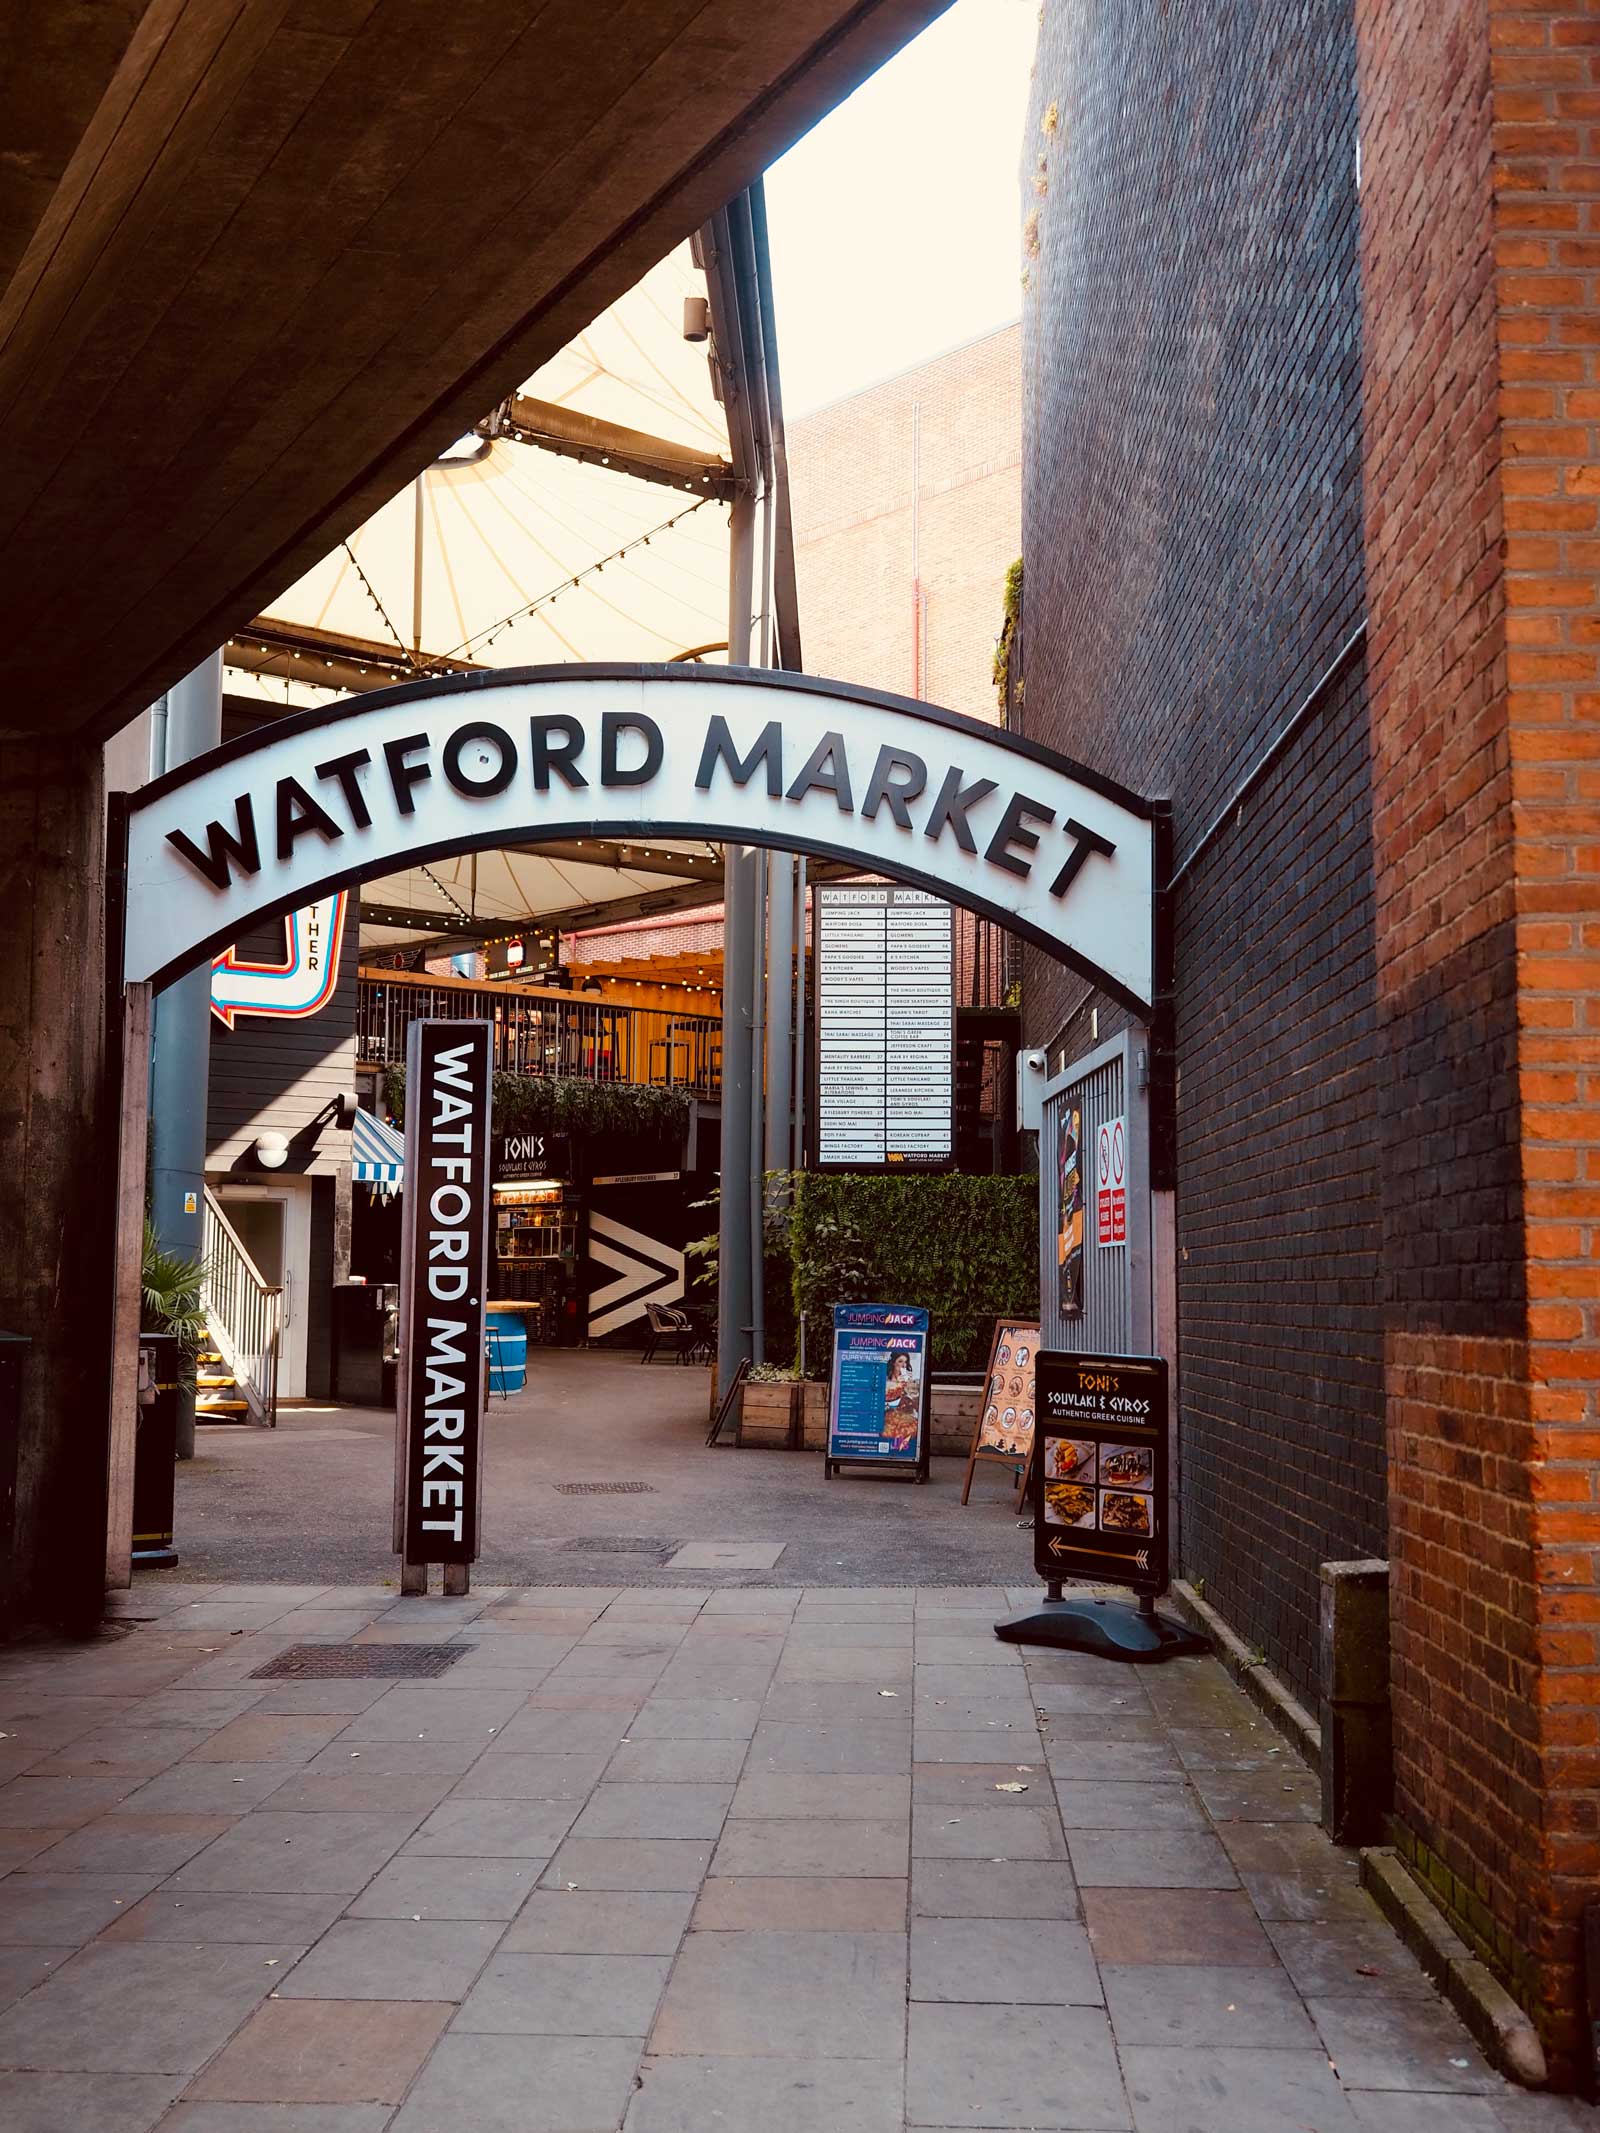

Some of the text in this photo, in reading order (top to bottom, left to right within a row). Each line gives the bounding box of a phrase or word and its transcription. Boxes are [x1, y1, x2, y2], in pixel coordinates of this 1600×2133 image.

[165, 712, 1117, 898] WATFORD MARKET
[504, 1135, 544, 1160] TONI'S
[422, 1042, 474, 1542] WATFORD MARKET
[848, 1313, 914, 1325] JUMPING JACK
[850, 1337, 888, 1348] JUMPING
[891, 1338, 916, 1349] JACK
[1077, 1372, 1119, 1392] TONI'S
[1048, 1392, 1096, 1408] SOUVLAKI
[1109, 1397, 1150, 1414] GYROS
[1052, 1408, 1145, 1424] AUTHENTIC GREEK CUISINE
